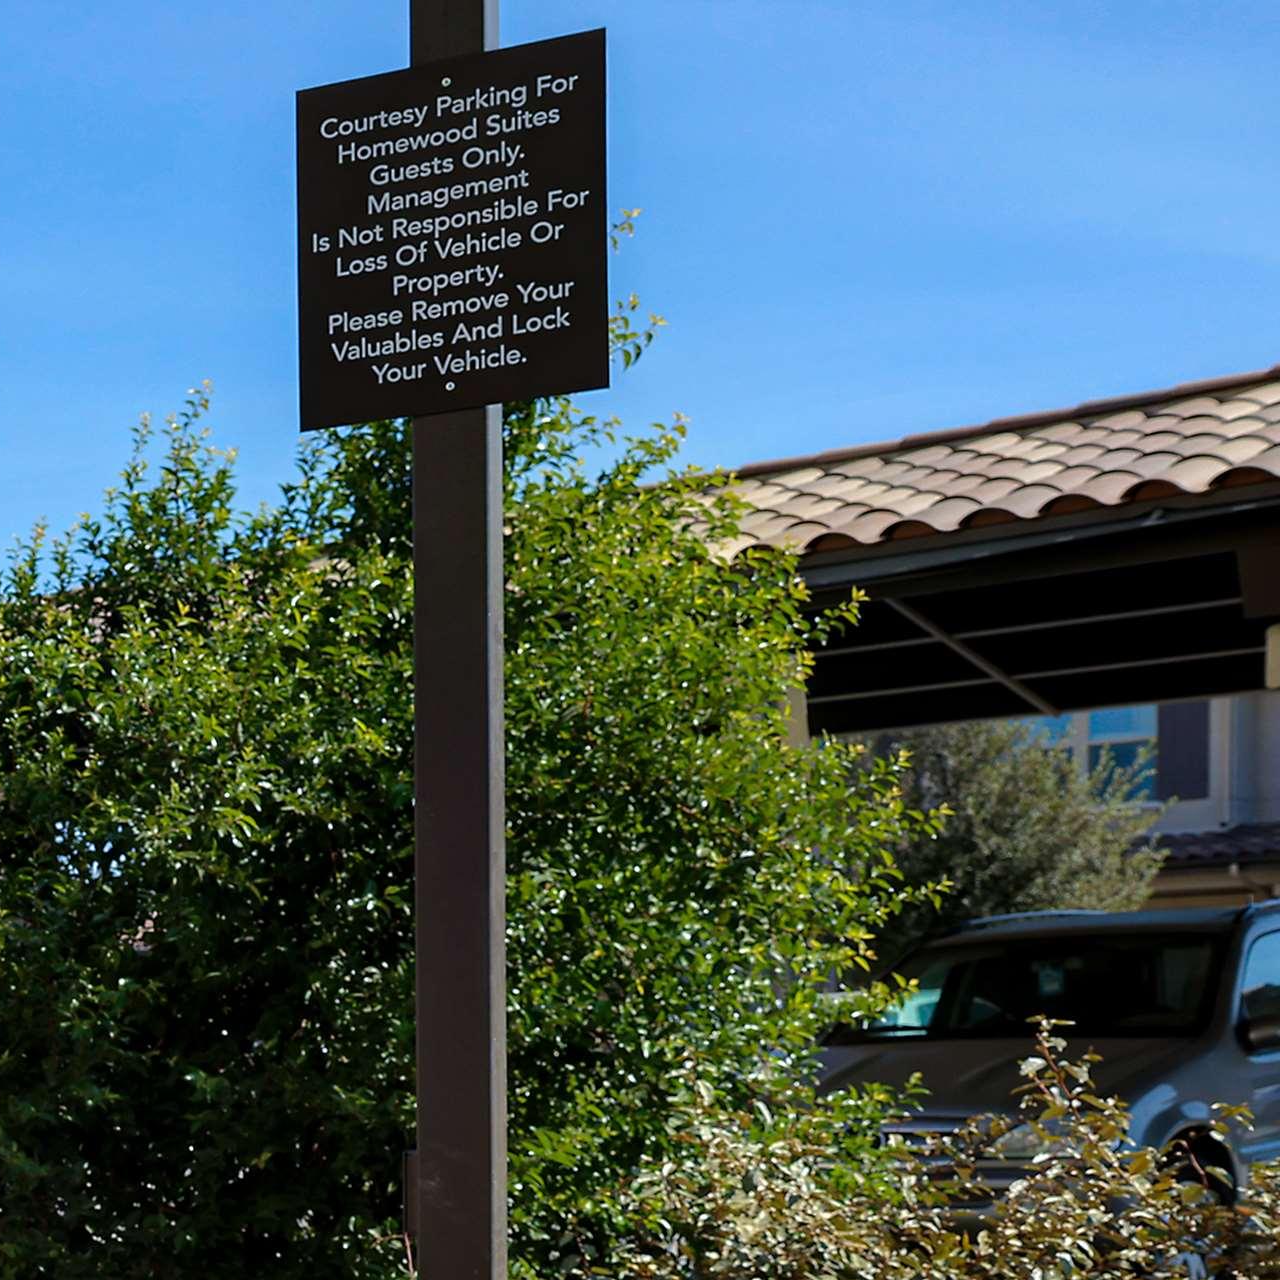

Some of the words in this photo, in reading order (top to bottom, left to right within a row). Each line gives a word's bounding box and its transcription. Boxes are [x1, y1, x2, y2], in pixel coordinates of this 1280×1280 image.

[319, 105, 429, 139] Courtesy
[436, 85, 527, 118] Parking
[536, 74, 579, 98] For
[338, 116, 478, 165] Homewood
[485, 108, 561, 136] Suites
[369, 156, 455, 186] Guests
[461, 140, 526, 169] Only.
[367, 169, 530, 216] Management
[312, 232, 331, 254] Is
[338, 224, 384, 249] Not
[392, 195, 539, 240] Responsible
[547, 188, 590, 212] For
[336, 254, 388, 278] Loss
[395, 240, 429, 267] Of
[433, 226, 522, 260] Vehicle
[529, 221, 565, 244] Or
[328, 309, 404, 336] Please
[411, 292, 510, 322] Remove
[515, 281, 575, 304] Your
[392, 264, 505, 297] Property.
[330, 328, 445, 363] Valuables
[451, 315, 503, 345] And
[512, 305, 571, 335] Lock
[371, 362, 428, 385] Your
[433, 343, 528, 376] Vehicle.
